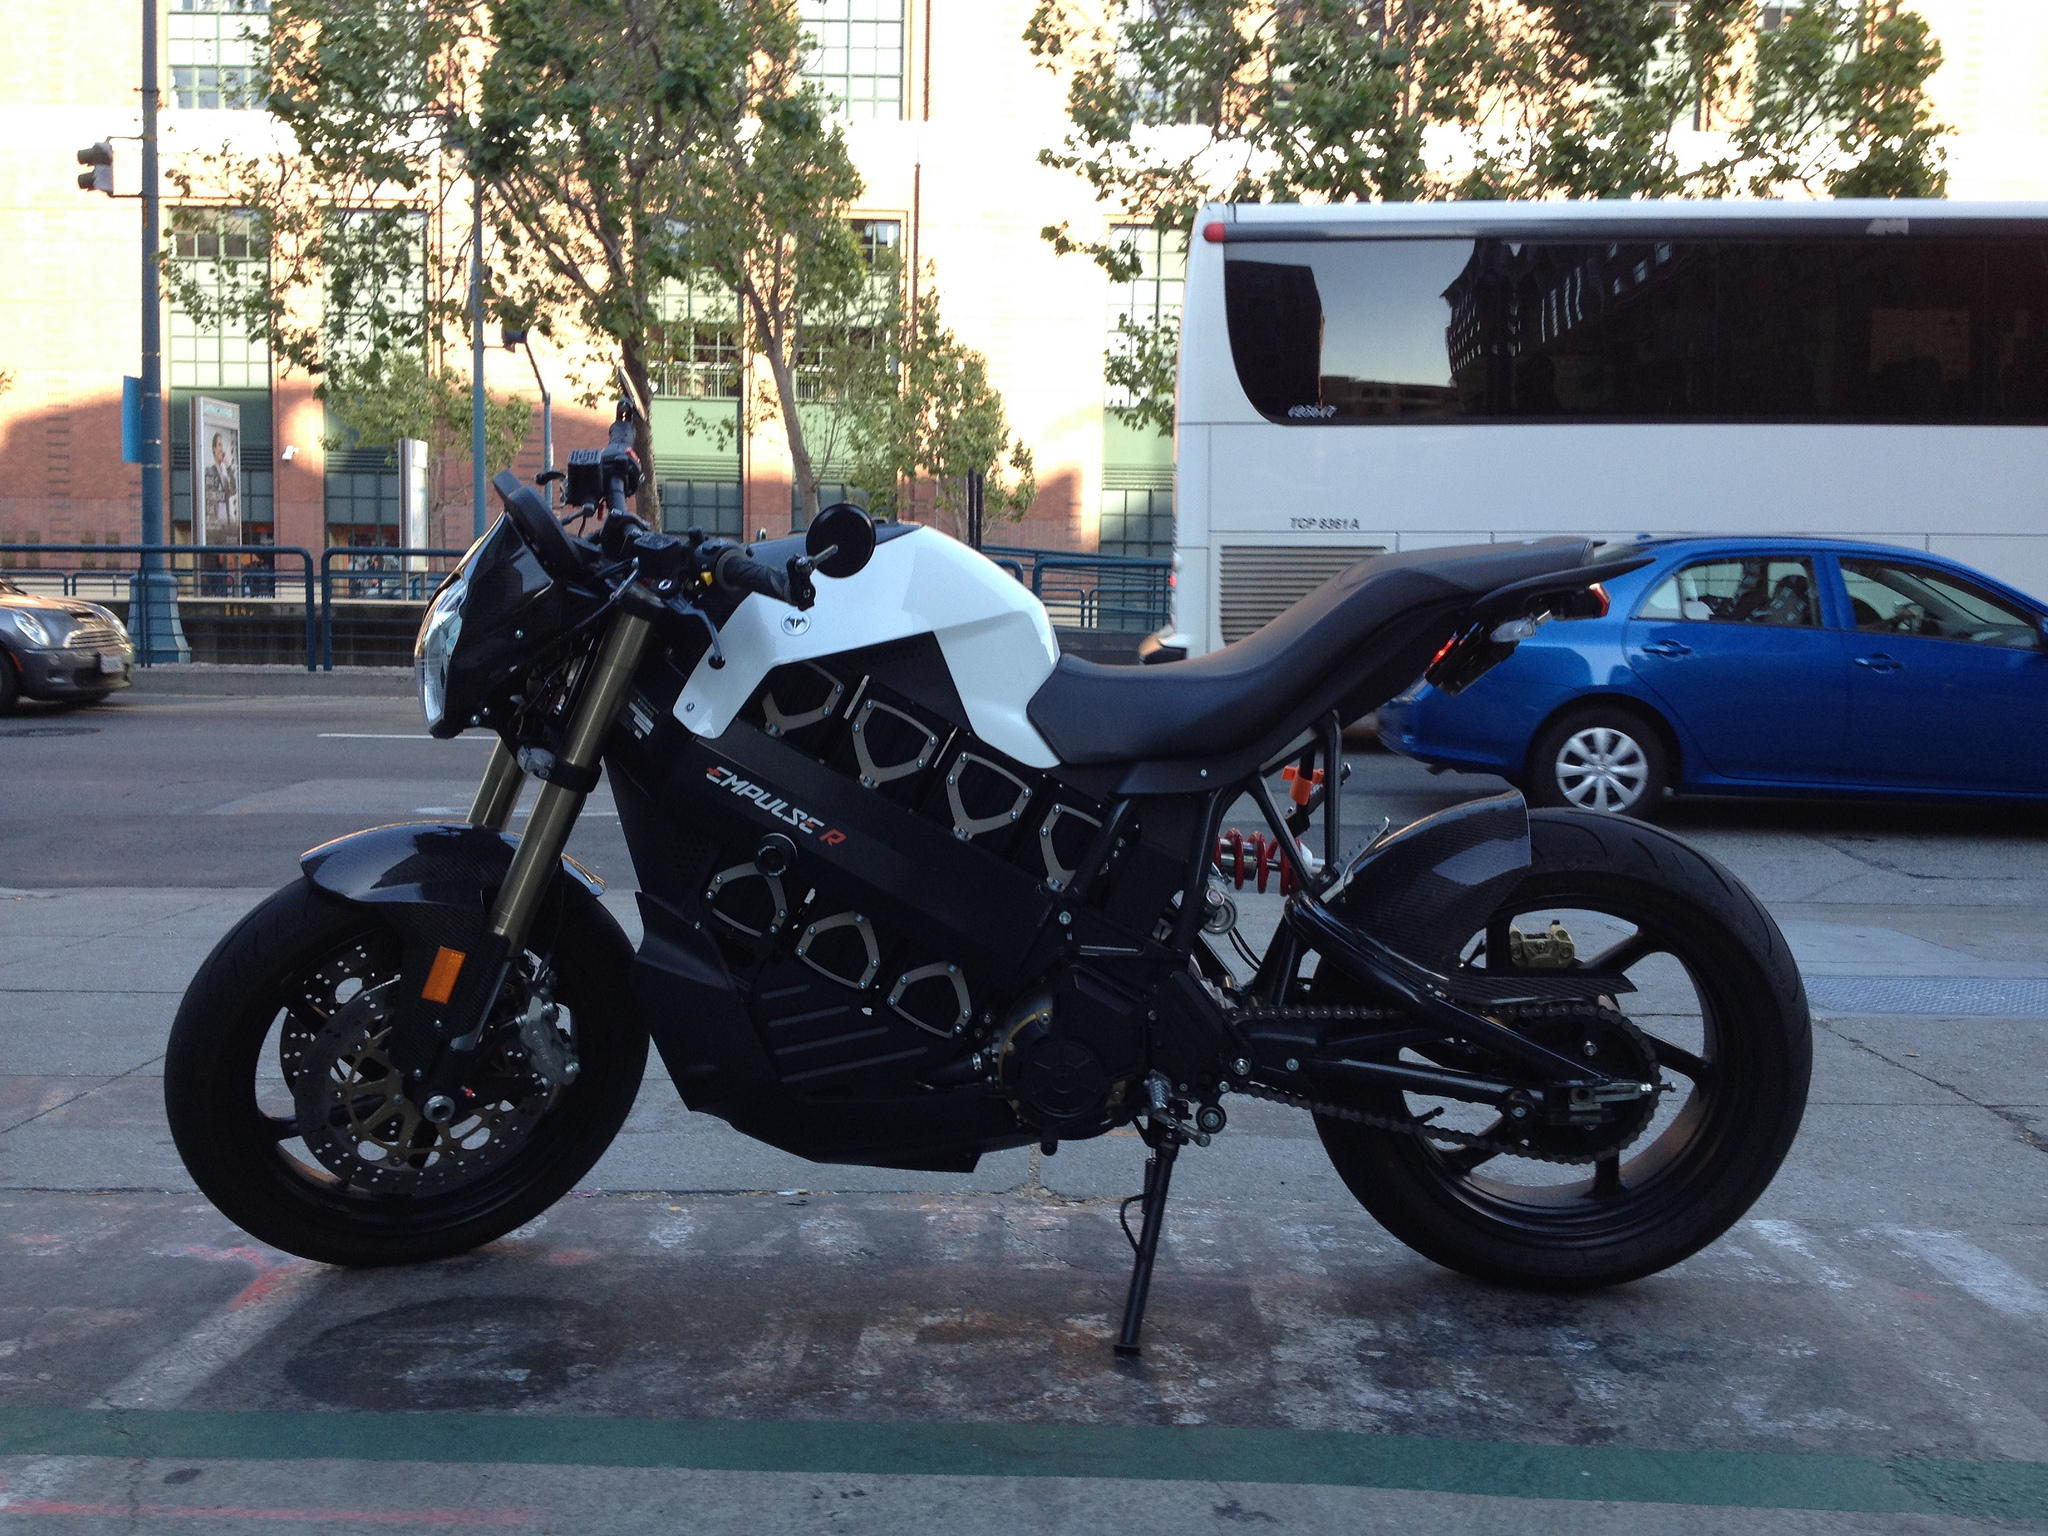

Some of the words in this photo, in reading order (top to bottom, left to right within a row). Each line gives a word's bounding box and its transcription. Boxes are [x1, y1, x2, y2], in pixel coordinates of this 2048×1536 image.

[1289, 517, 1317, 529] TCP
[705, 765, 825, 835] EMPULSE
[819, 829, 847, 846] R
